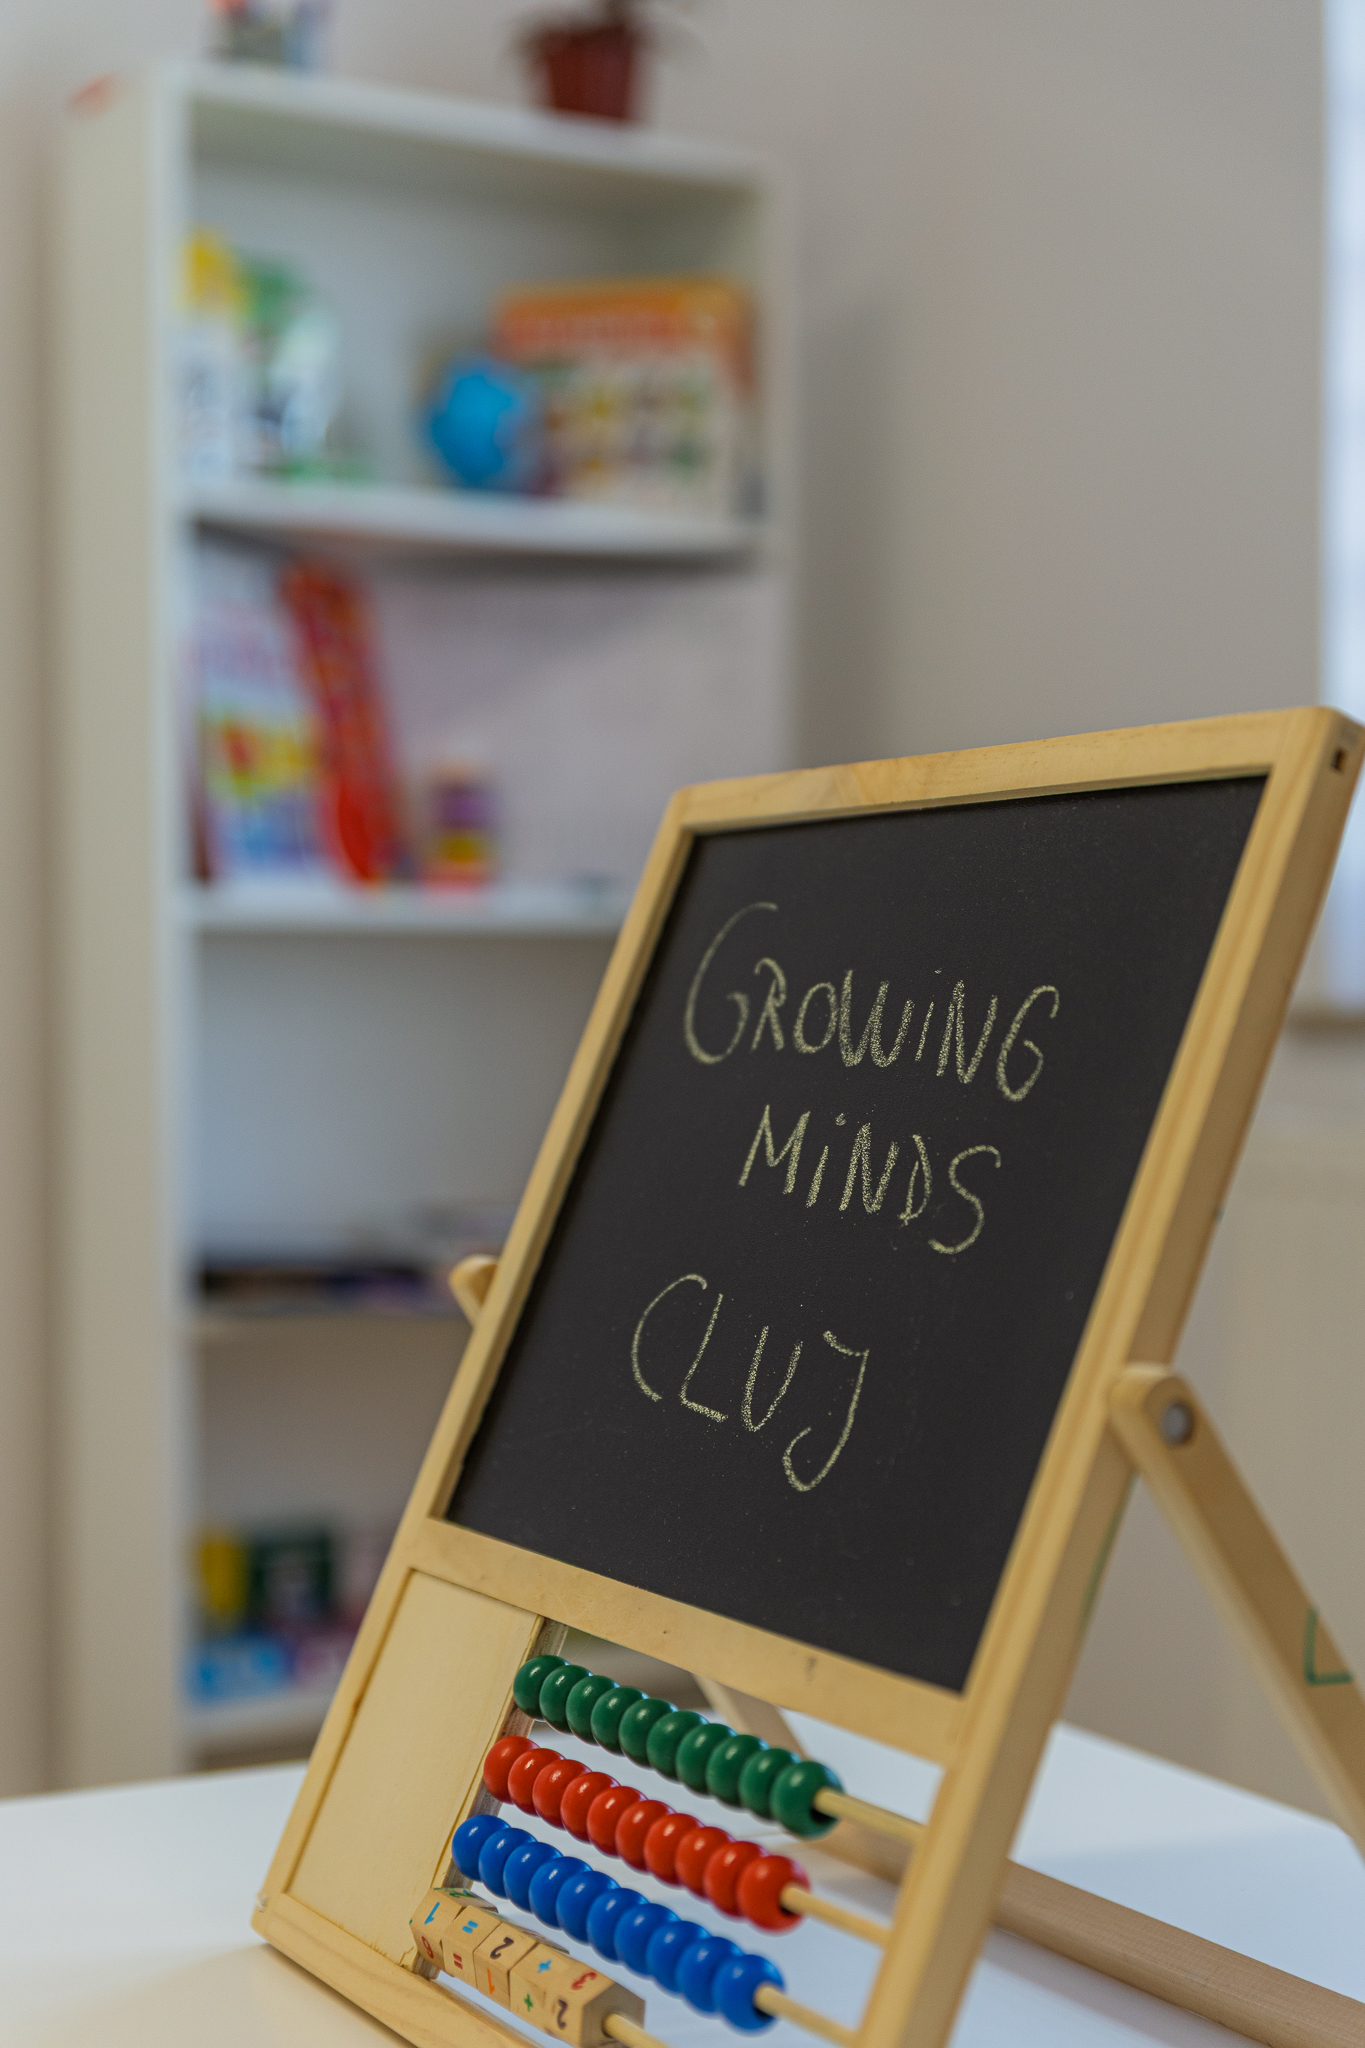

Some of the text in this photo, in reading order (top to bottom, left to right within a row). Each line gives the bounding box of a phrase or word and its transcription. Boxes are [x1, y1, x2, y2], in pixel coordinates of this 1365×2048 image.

[632, 1274, 869, 1492] CLUJ
[424, 1901, 440, 1925] 1
[490, 1936, 515, 1959] 2
[486, 1967, 495, 1994] 1
[557, 1998, 569, 2030] 2
